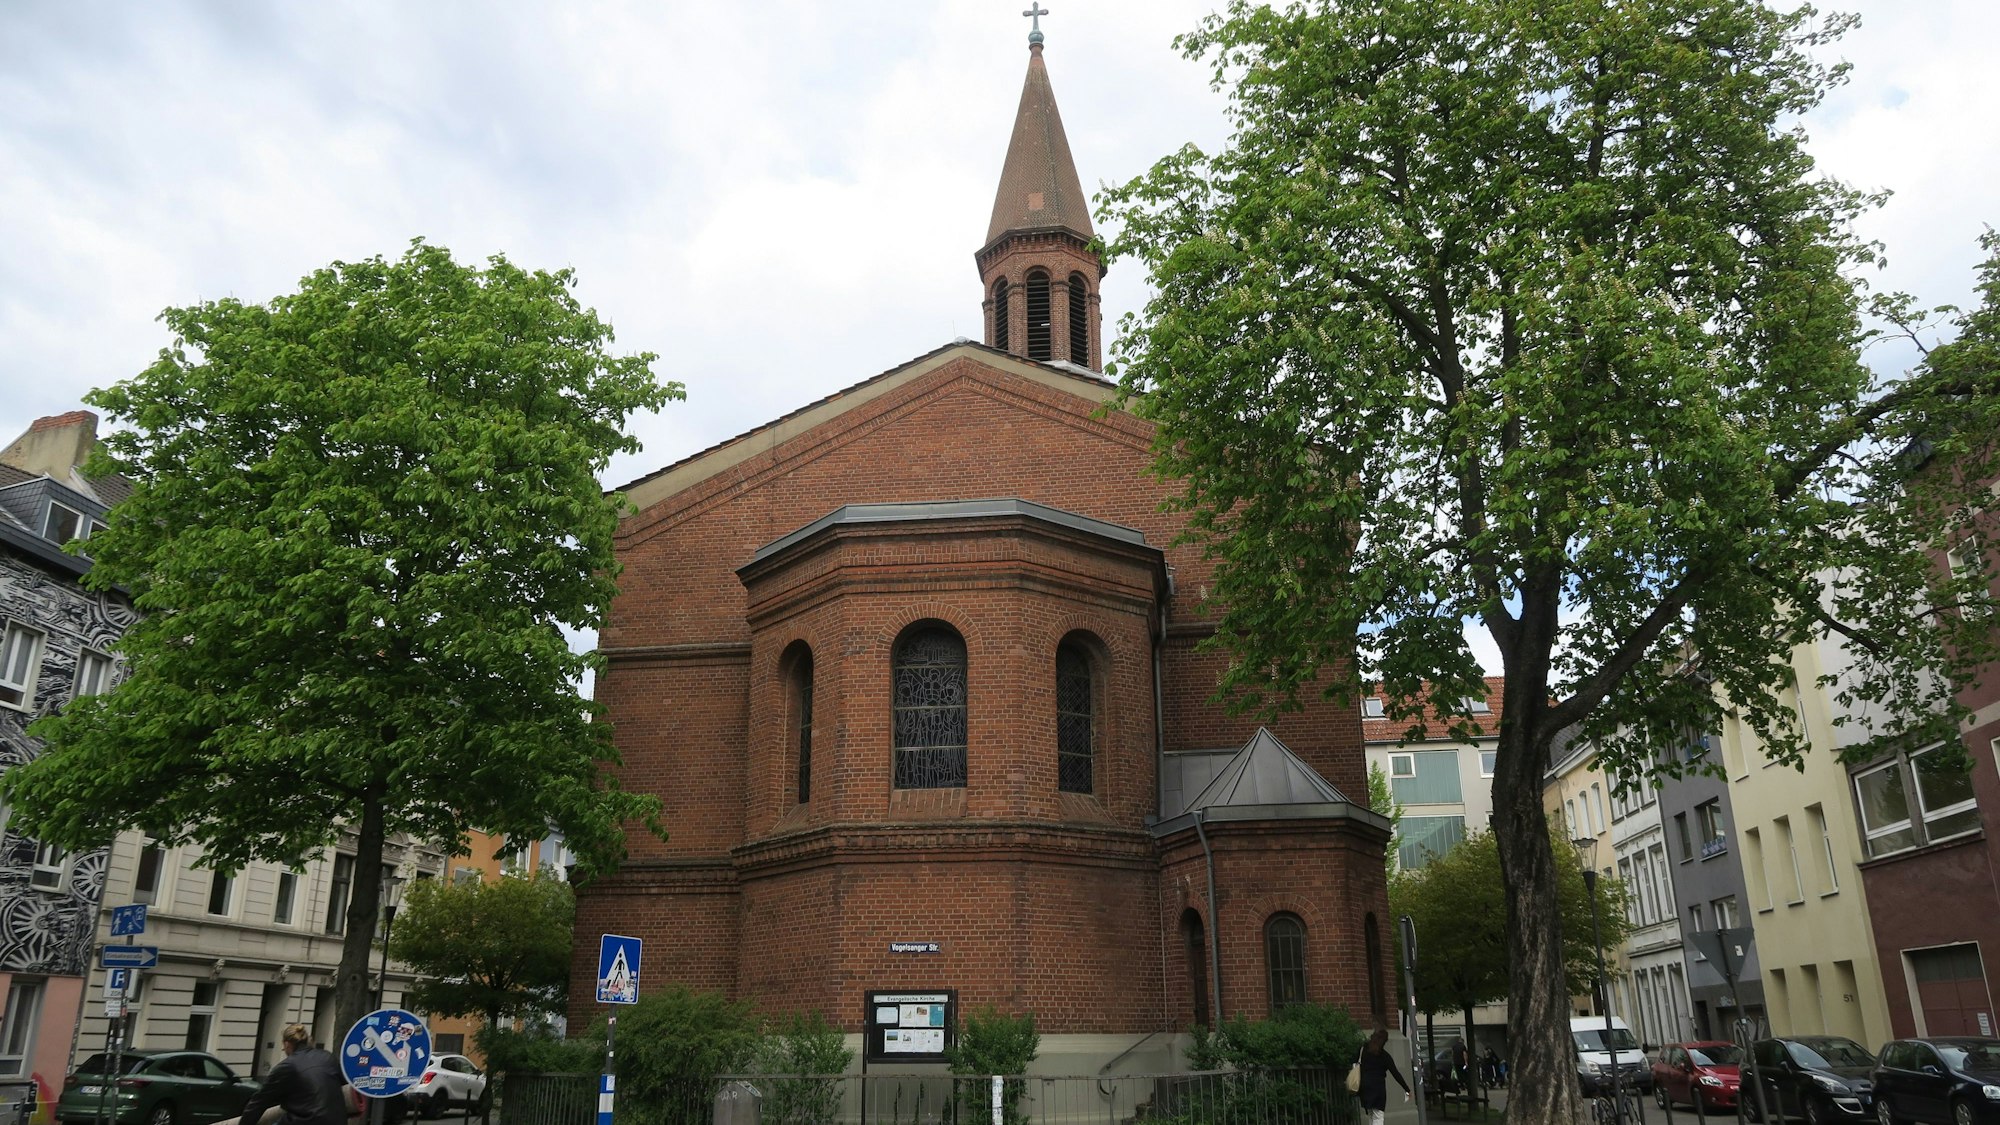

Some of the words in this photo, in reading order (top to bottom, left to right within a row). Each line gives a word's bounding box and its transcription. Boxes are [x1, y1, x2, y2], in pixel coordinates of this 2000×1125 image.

[891, 943, 927, 952] Vogelsanger
[929, 943, 939, 951] Str.
[1843, 994, 1854, 1003] 51
